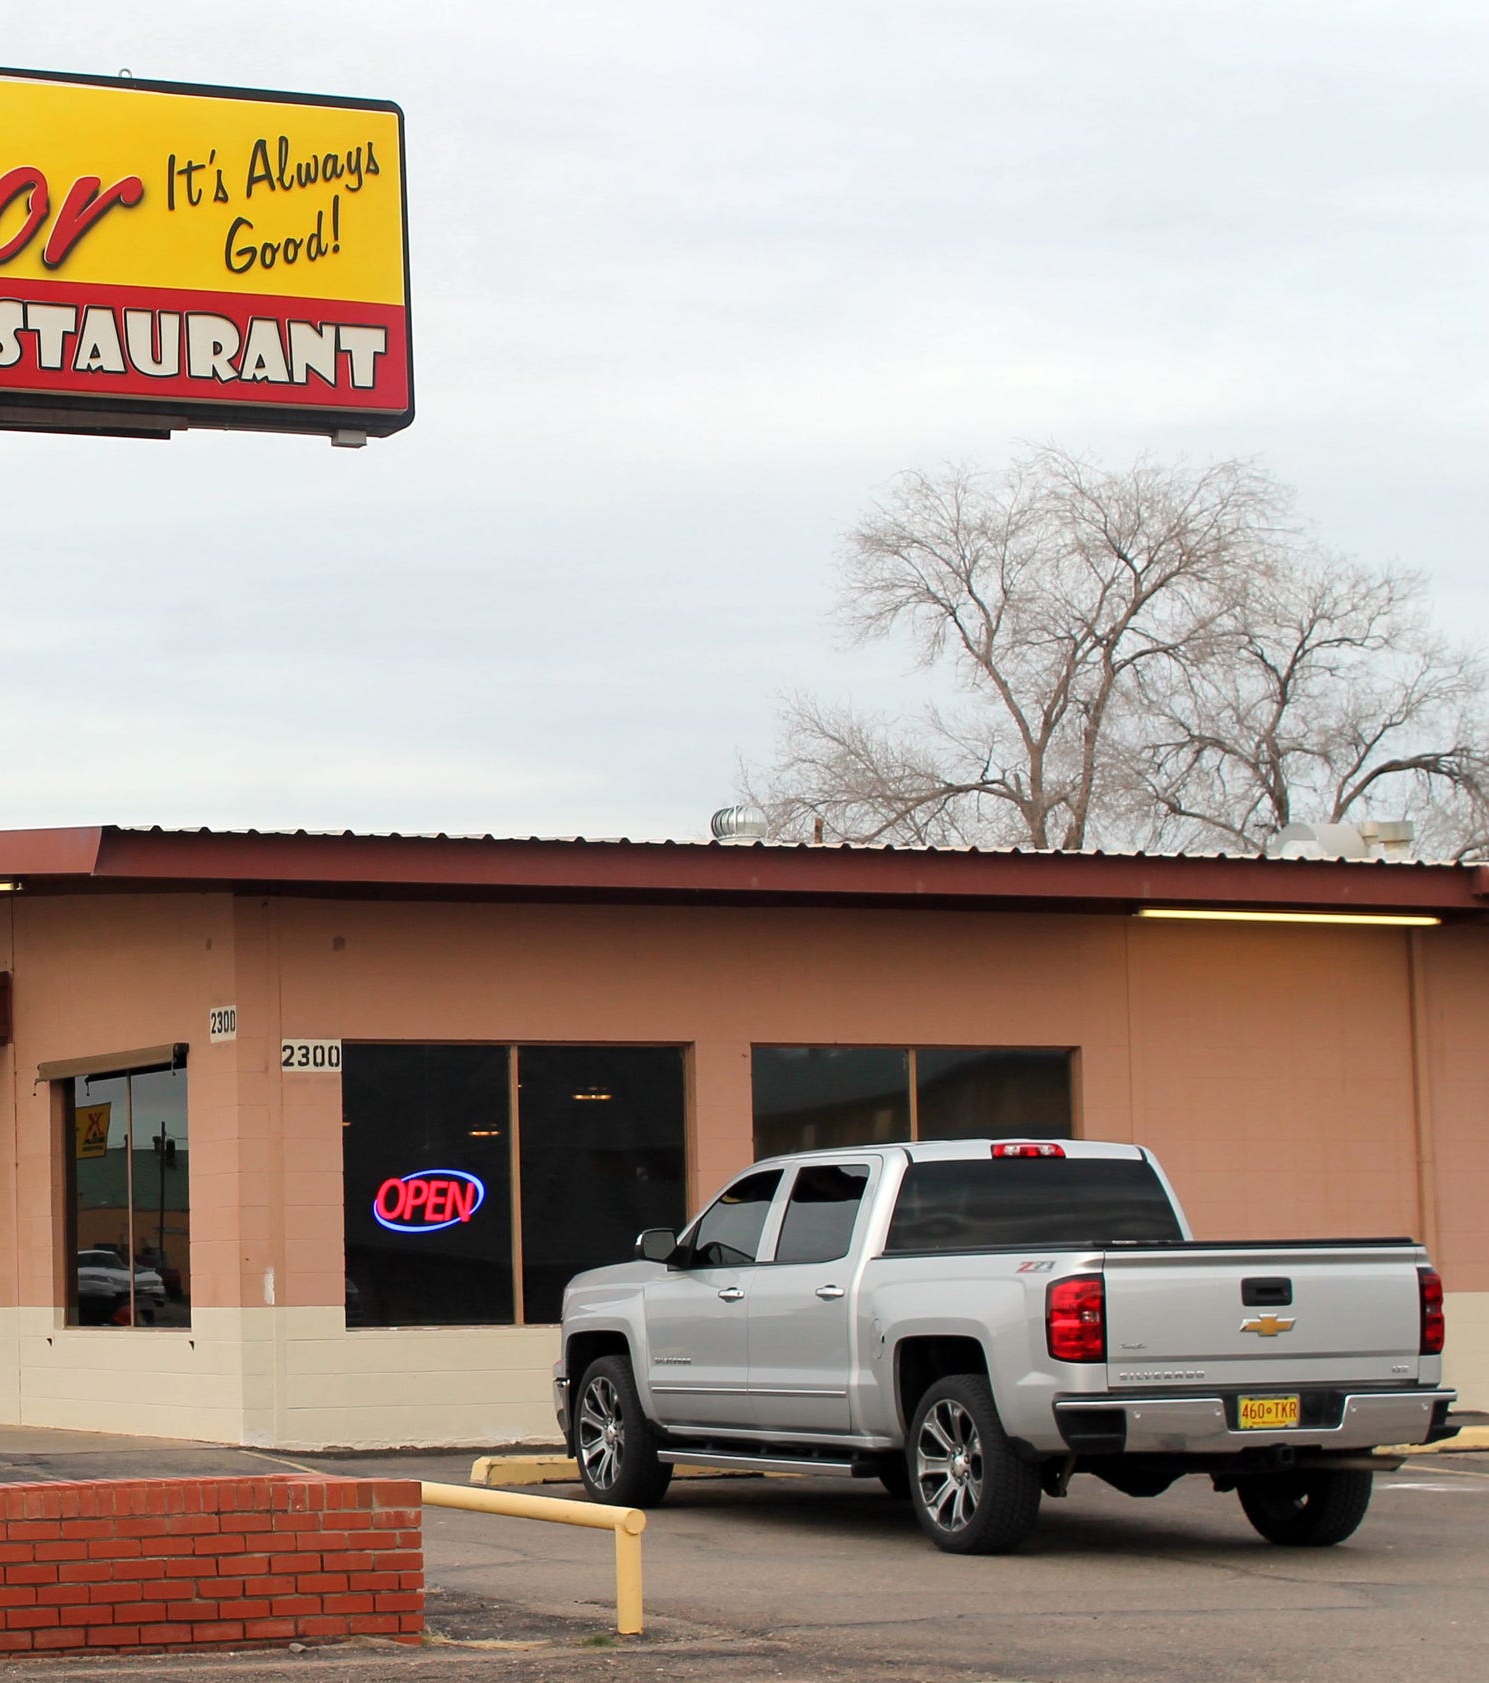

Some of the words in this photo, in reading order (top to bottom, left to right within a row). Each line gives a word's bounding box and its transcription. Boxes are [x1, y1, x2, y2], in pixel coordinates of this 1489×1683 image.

[167, 149, 229, 211] It's
[246, 136, 381, 199] Always
[224, 194, 341, 274] Good!
[210, 1009, 237, 1035] 2300
[281, 1044, 341, 1068] 2300
[375, 1177, 476, 1223] OPEN
[1015, 1260, 1057, 1274] Z71
[1119, 1369, 1206, 1382] SILVERADO
